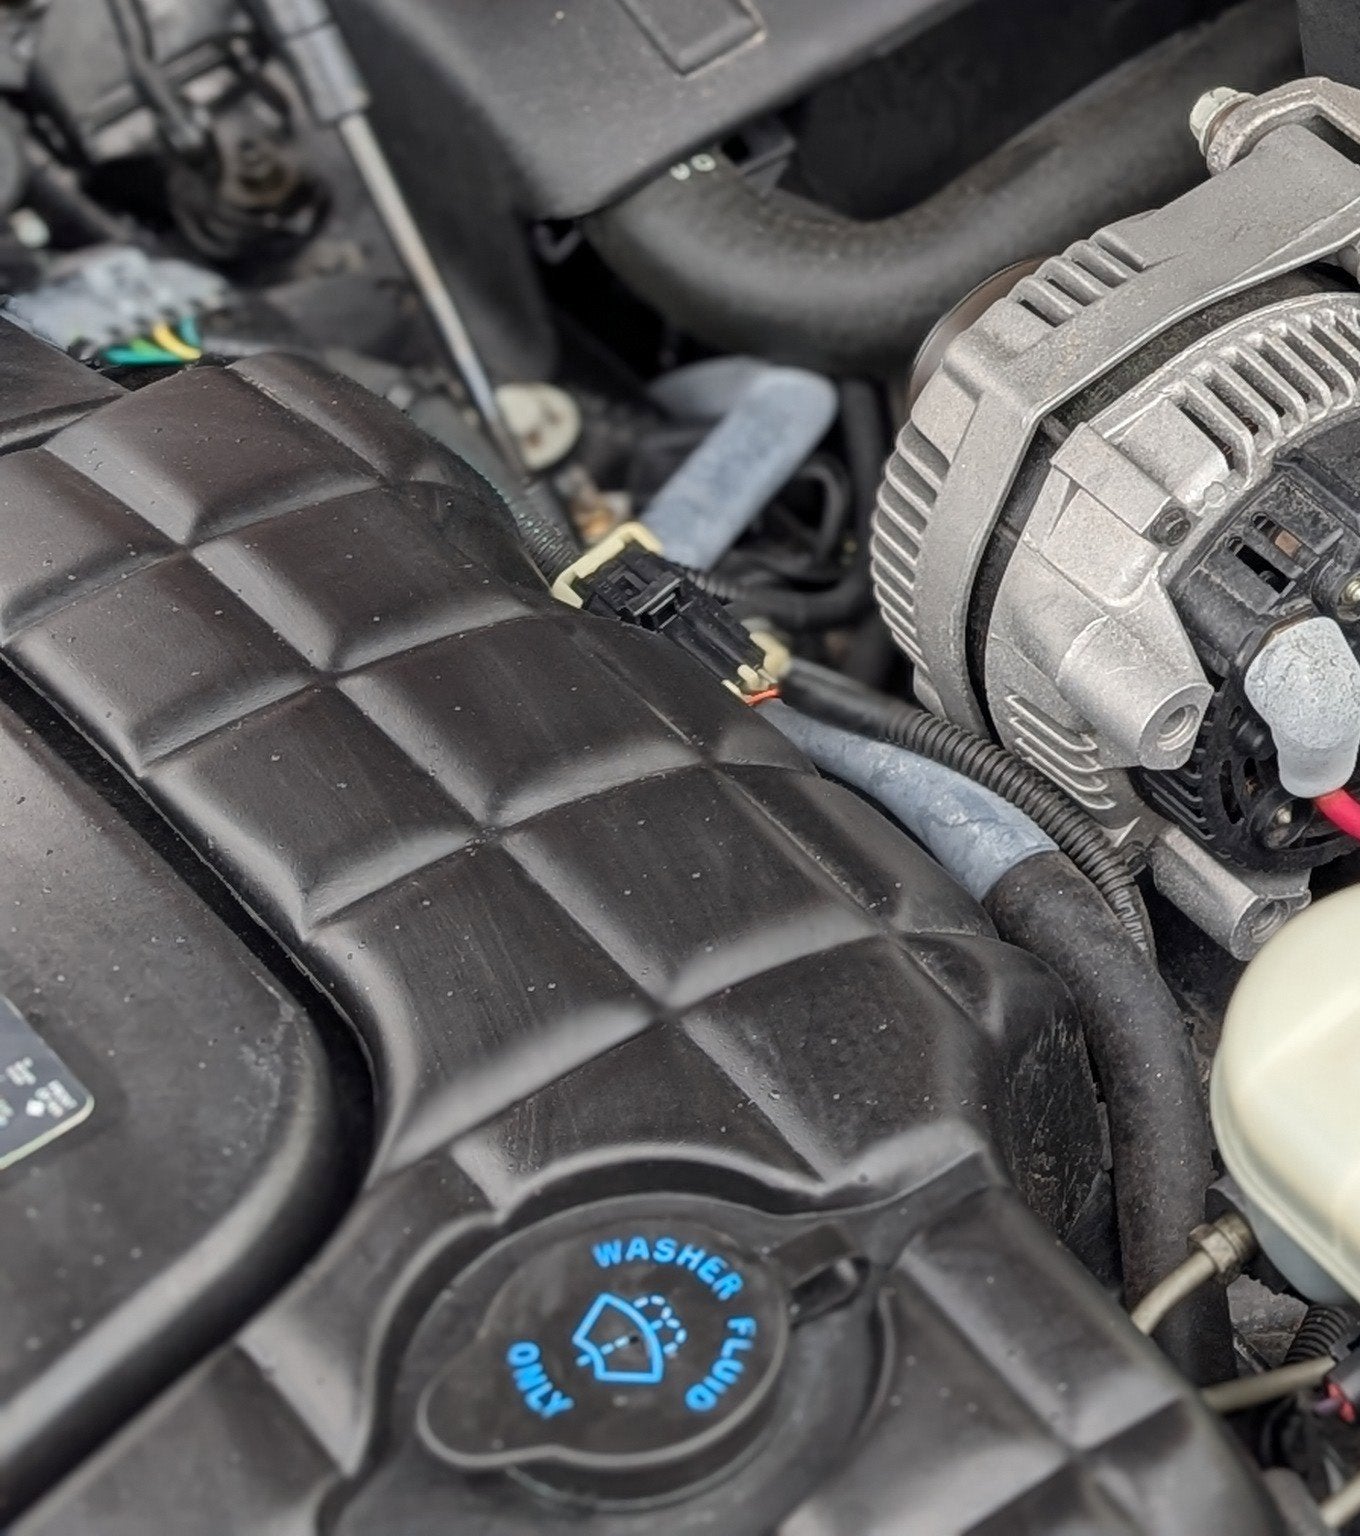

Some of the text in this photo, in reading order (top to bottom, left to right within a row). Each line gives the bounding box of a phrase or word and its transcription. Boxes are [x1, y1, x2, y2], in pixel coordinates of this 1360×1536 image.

[506, 1339, 575, 1418] ONLY
[592, 1234, 757, 1413] WASHER FLUID
